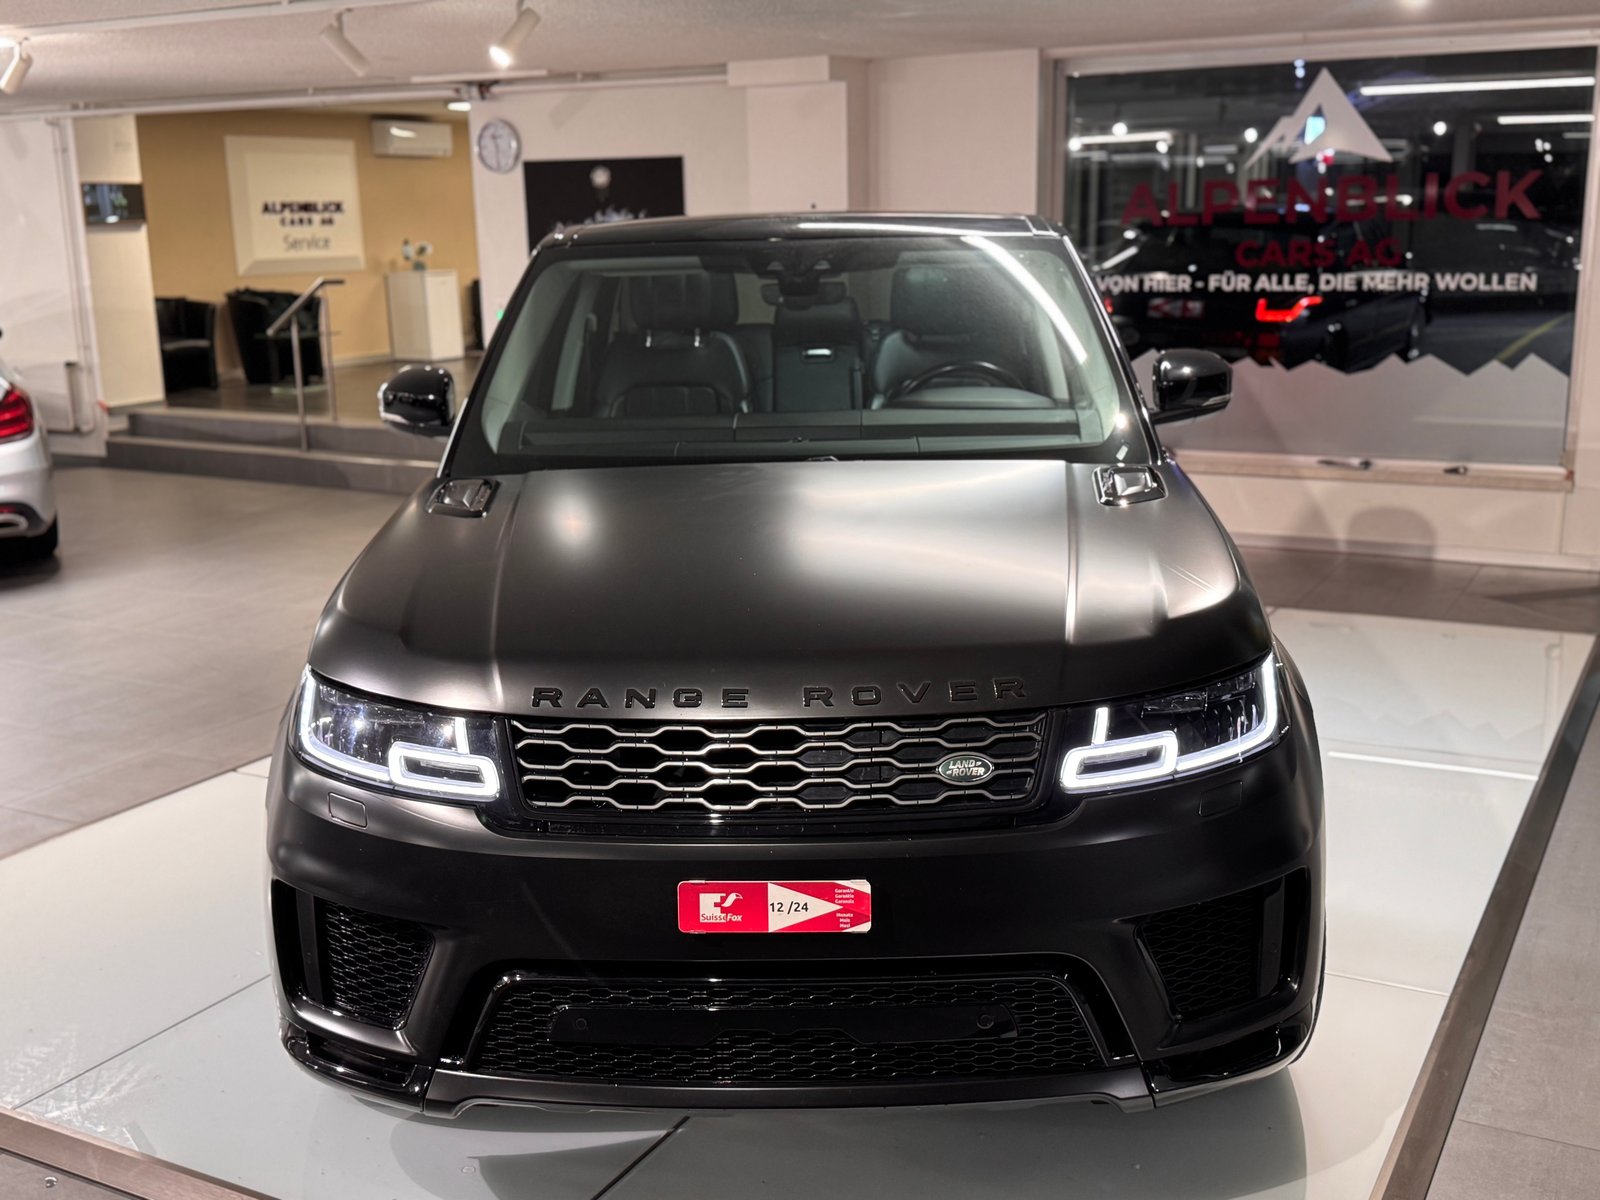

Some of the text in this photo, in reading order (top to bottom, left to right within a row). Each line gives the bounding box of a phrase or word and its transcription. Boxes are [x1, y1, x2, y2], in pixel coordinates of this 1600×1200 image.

[1120, 169, 1542, 226] ALPENBLICK
[282, 234, 332, 251] Service
[1235, 237, 1403, 268] CARS AG
[1097, 274, 1140, 294] VON
[1143, 273, 1192, 292] HIER
[1208, 269, 1252, 292] FÜR
[1254, 273, 1315, 293] ALLE,
[1319, 272, 1358, 292] DIE
[1361, 272, 1430, 292] MEHR
[1435, 271, 1539, 292] WOLLEN
[532, 678, 1026, 708] RANGE ROVER
[949, 760, 975, 769] LAND
[952, 767, 985, 776] ROVER
[770, 902, 784, 912] 12
